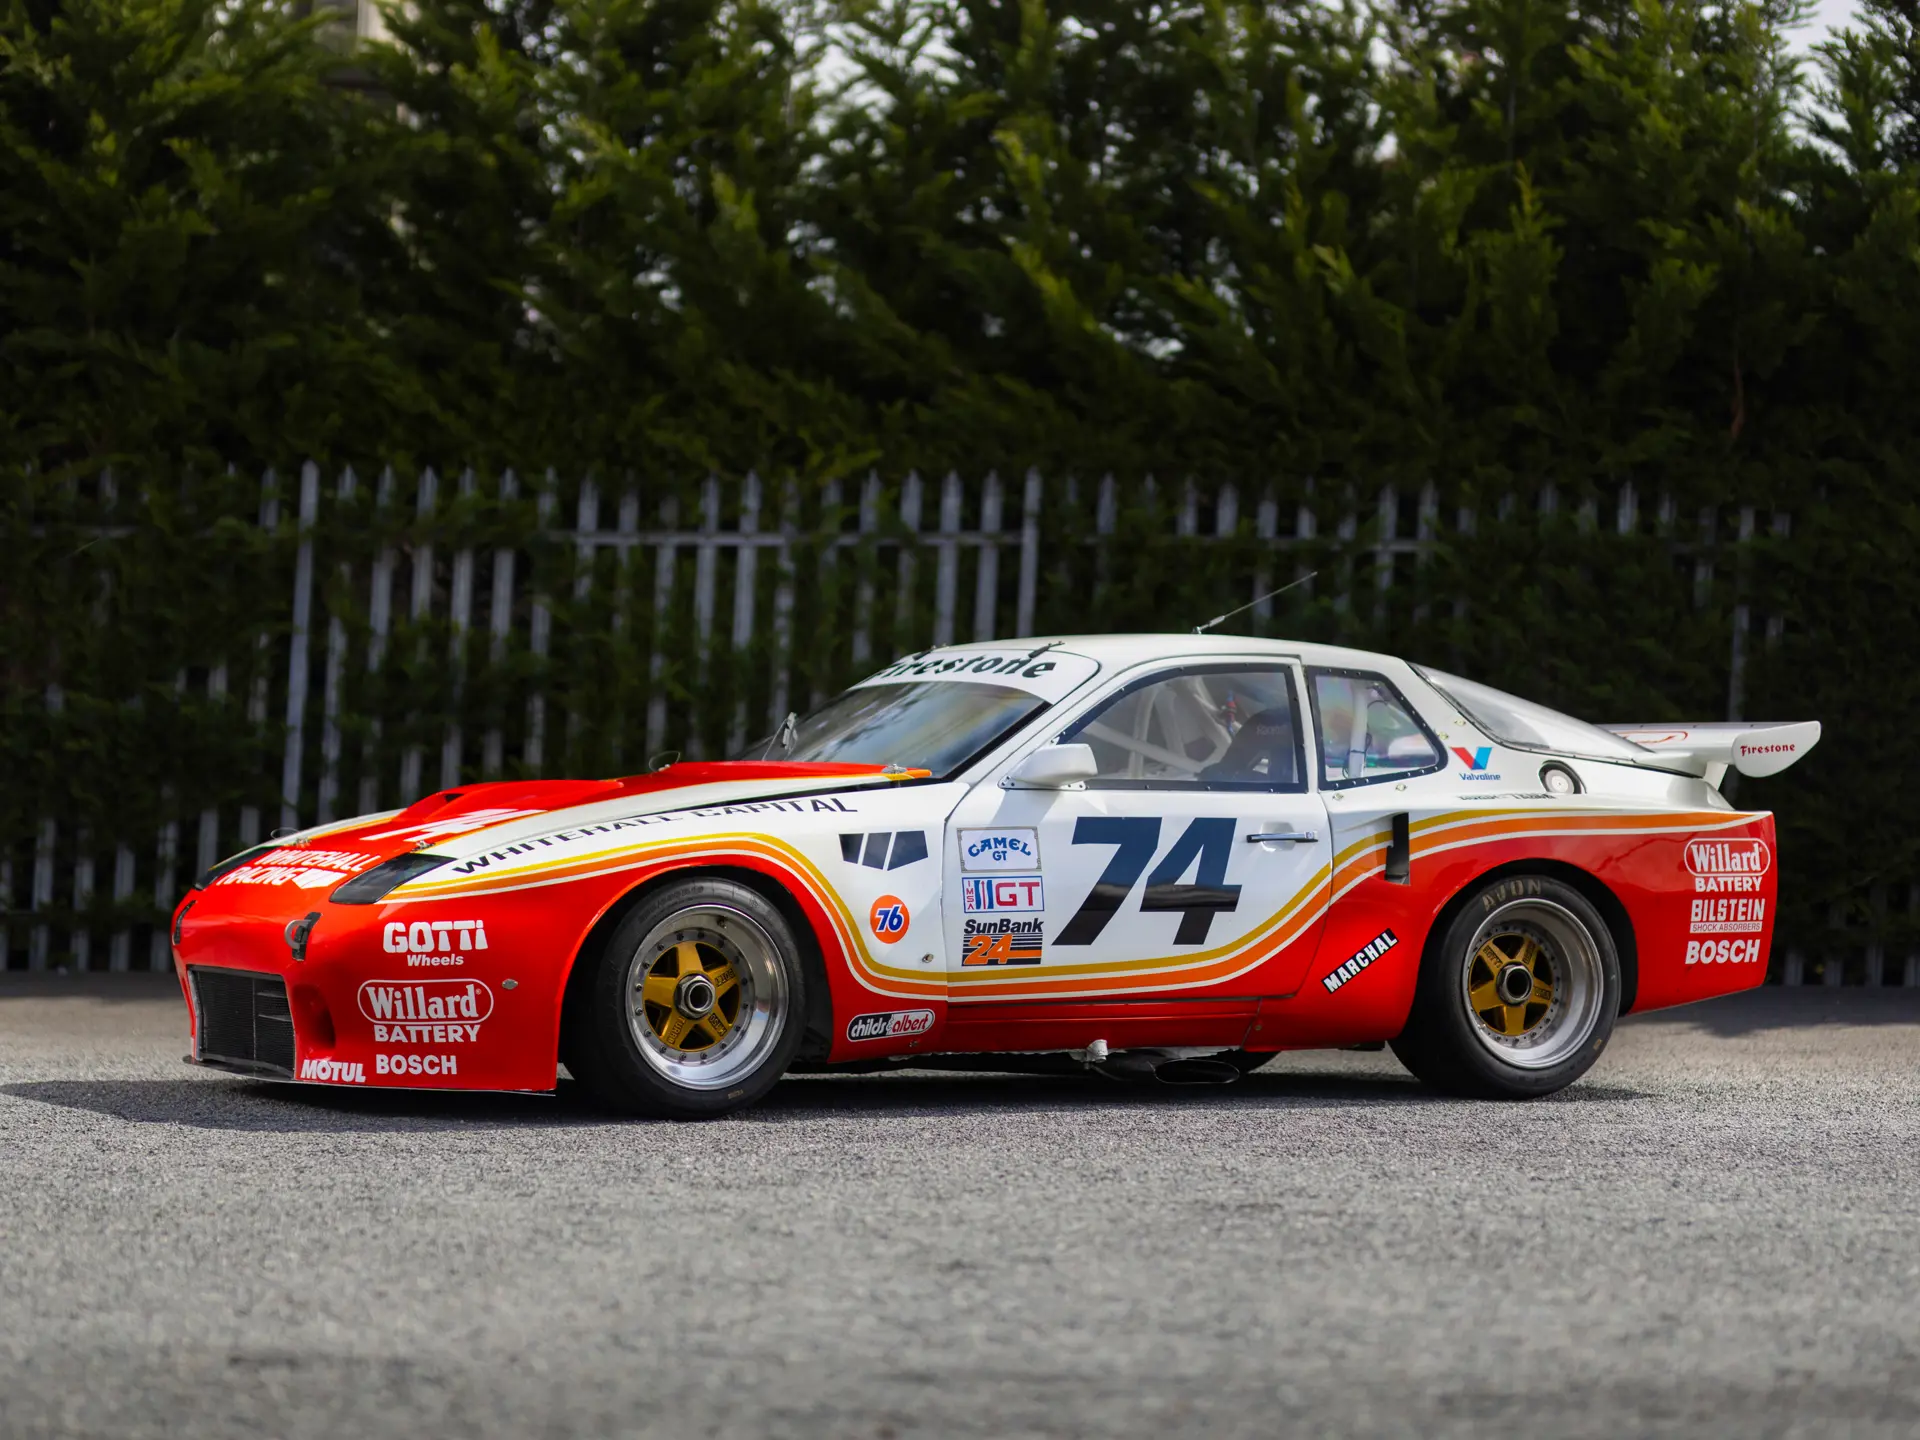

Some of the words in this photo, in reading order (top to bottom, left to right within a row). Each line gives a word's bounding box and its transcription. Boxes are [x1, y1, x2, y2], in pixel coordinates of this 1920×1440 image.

[1740, 743, 1796, 757] Firestone
[1459, 772, 1502, 781] Valvoline
[451, 814, 684, 874] WHITEHALL
[690, 797, 858, 817] CAPITAL
[968, 837, 1032, 857] CAMEL
[254, 849, 382, 872] WHITEHALL
[992, 850, 1008, 861] GT
[1690, 842, 1762, 873] Willard
[215, 866, 309, 886] RACING
[1050, 816, 1243, 946] 74
[1695, 876, 1763, 893] BATTERY
[995, 881, 1041, 907] GT
[1482, 879, 1542, 912] AVON
[875, 904, 904, 933] 76
[1690, 898, 1766, 922] BILSTEIN
[963, 917, 1044, 934] SunBank
[1692, 923, 1718, 932] SHOCK
[1718, 922, 1761, 931] ABSORBERS
[406, 953, 465, 967] Wheels
[963, 933, 1014, 965] 24
[1685, 939, 1761, 965] BOSCH
[1323, 932, 1398, 993] MARCHAL
[365, 983, 479, 1020] Willard
[373, 1024, 481, 1043] BATTERY
[300, 1058, 367, 1083] MOTUL
[375, 1053, 458, 1075] BOSCH
